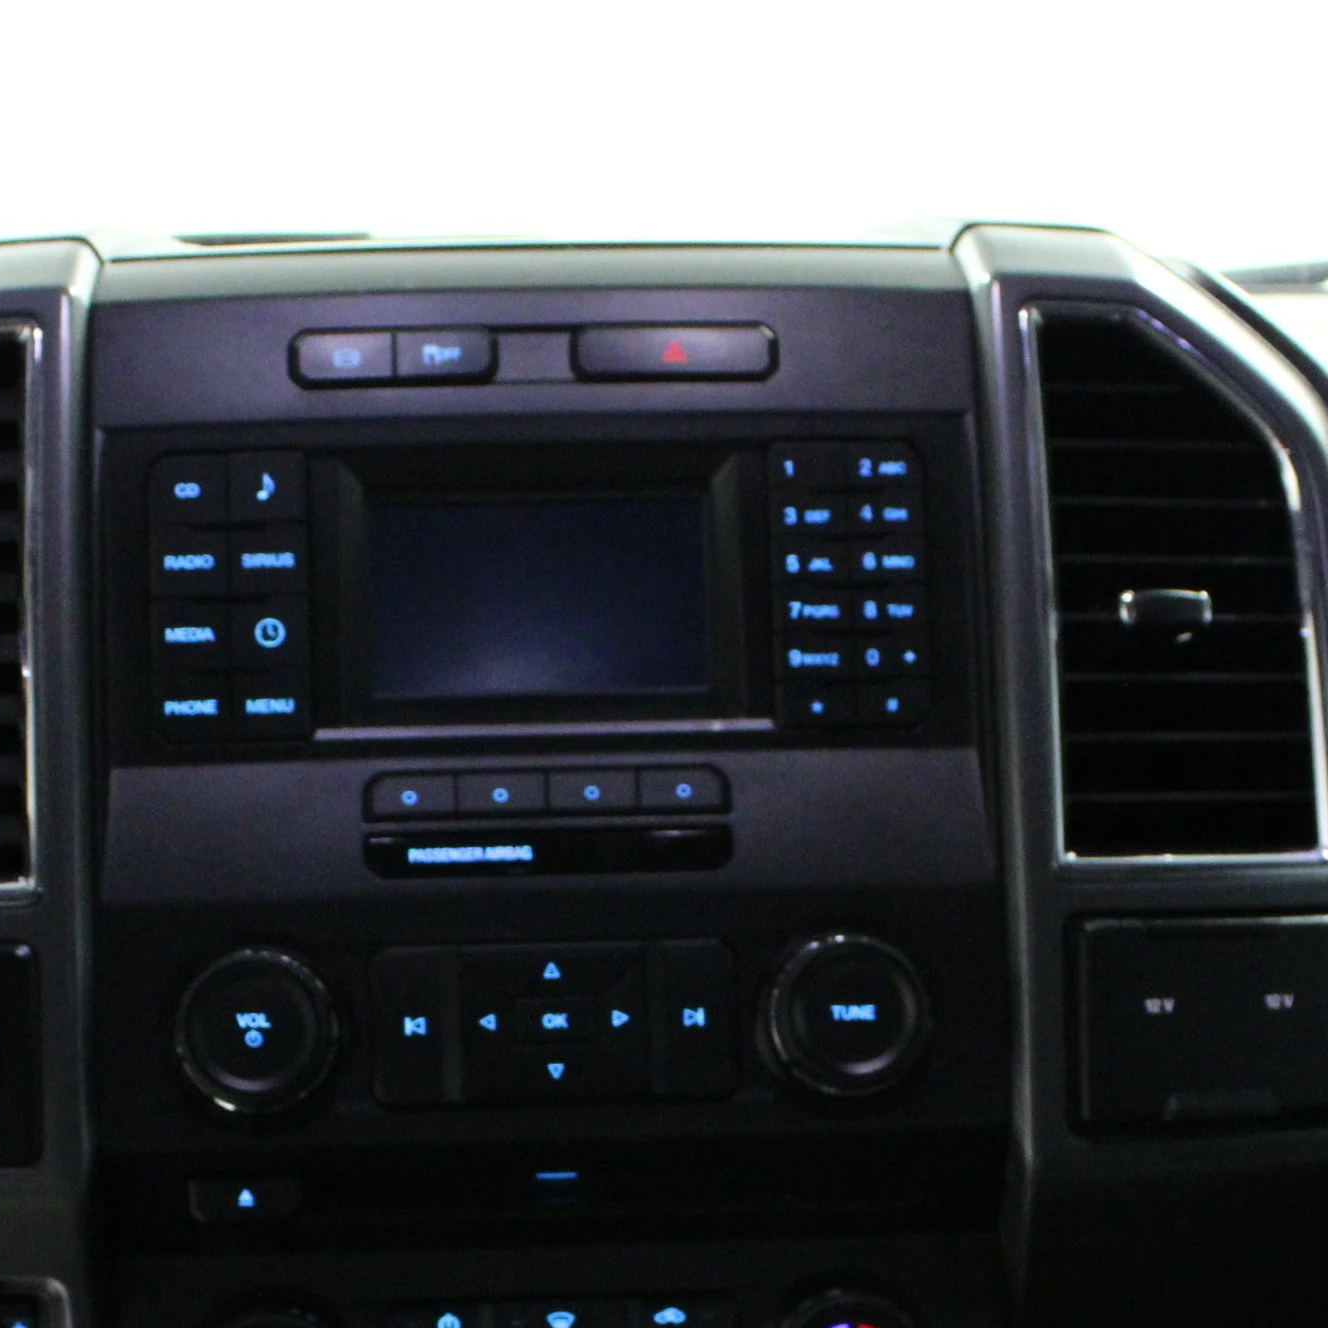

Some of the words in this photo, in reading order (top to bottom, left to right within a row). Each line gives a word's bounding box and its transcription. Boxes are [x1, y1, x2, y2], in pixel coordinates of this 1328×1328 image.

[784, 459, 795, 477] 1
[859, 458, 873, 477] 2
[173, 482, 202, 499] CD
[783, 506, 799, 526] 3
[163, 553, 216, 571] RADIO
[241, 551, 297, 569] SIRIUS
[788, 601, 803, 620] 7
[164, 626, 216, 644] MEDIA
[163, 698, 219, 716] PHONE
[245, 698, 296, 715] MENU
[235, 1012, 272, 1029] VOL
[541, 1013, 569, 1030] OK
[830, 1004, 877, 1022] TUNE
